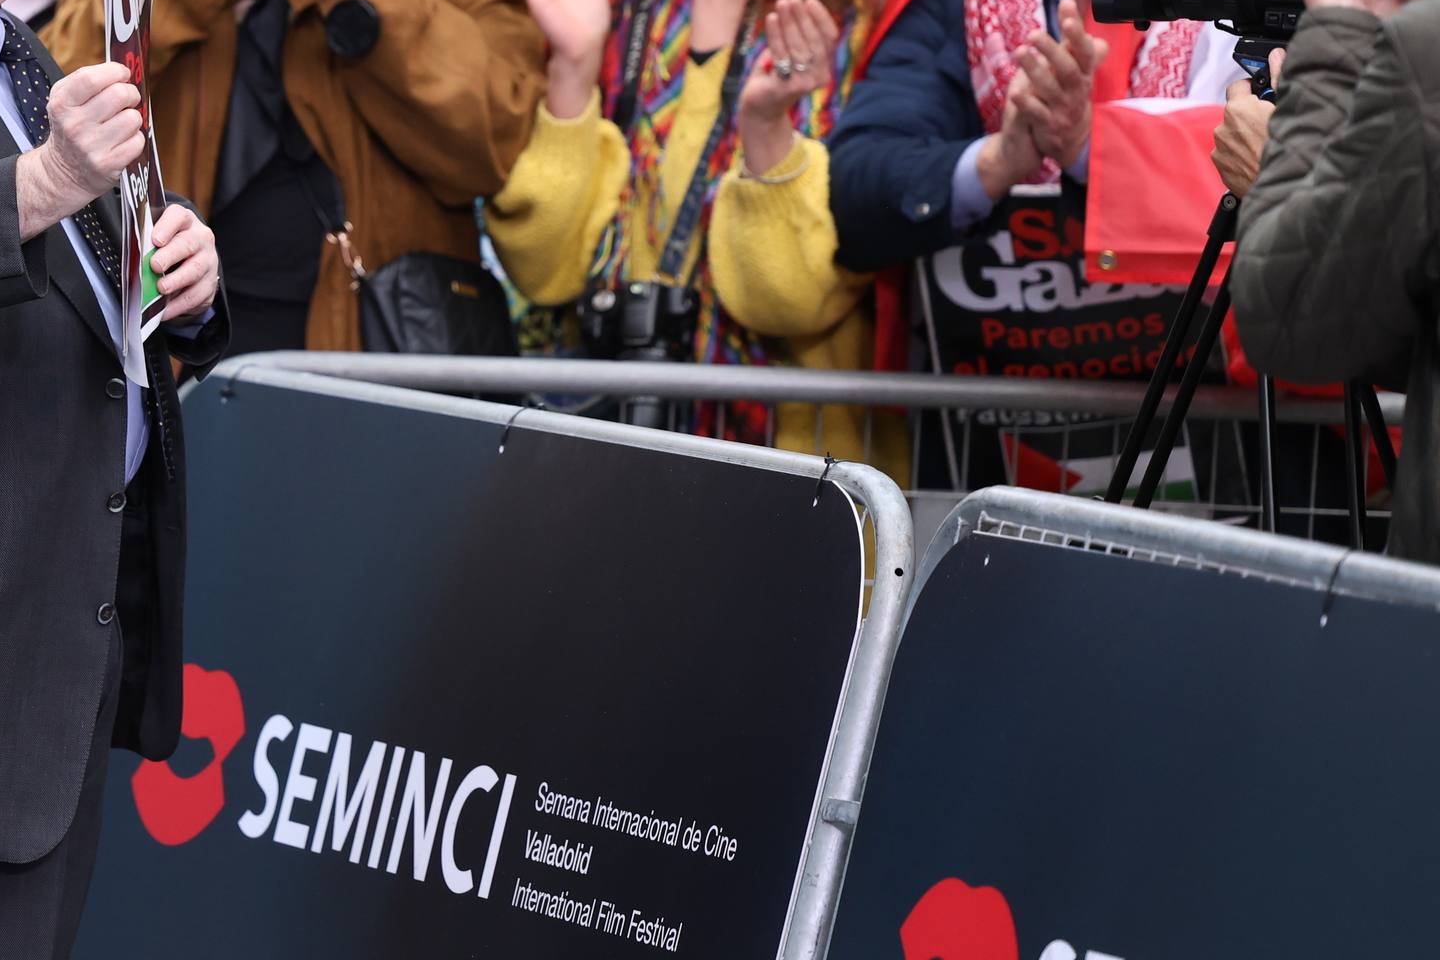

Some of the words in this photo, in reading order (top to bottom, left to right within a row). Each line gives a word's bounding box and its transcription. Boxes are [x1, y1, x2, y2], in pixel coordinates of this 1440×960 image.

[981, 313, 1165, 350] Paremos
[237, 714, 517, 899] SEMINCI
[535, 781, 591, 823] Semana
[592, 796, 682, 847] Internacional
[682, 820, 701, 852] de
[704, 825, 738, 861] Cine
[525, 829, 593, 874] Valladolid
[512, 878, 596, 927] International
[595, 900, 626, 937] Film
[627, 909, 683, 952] Festival
